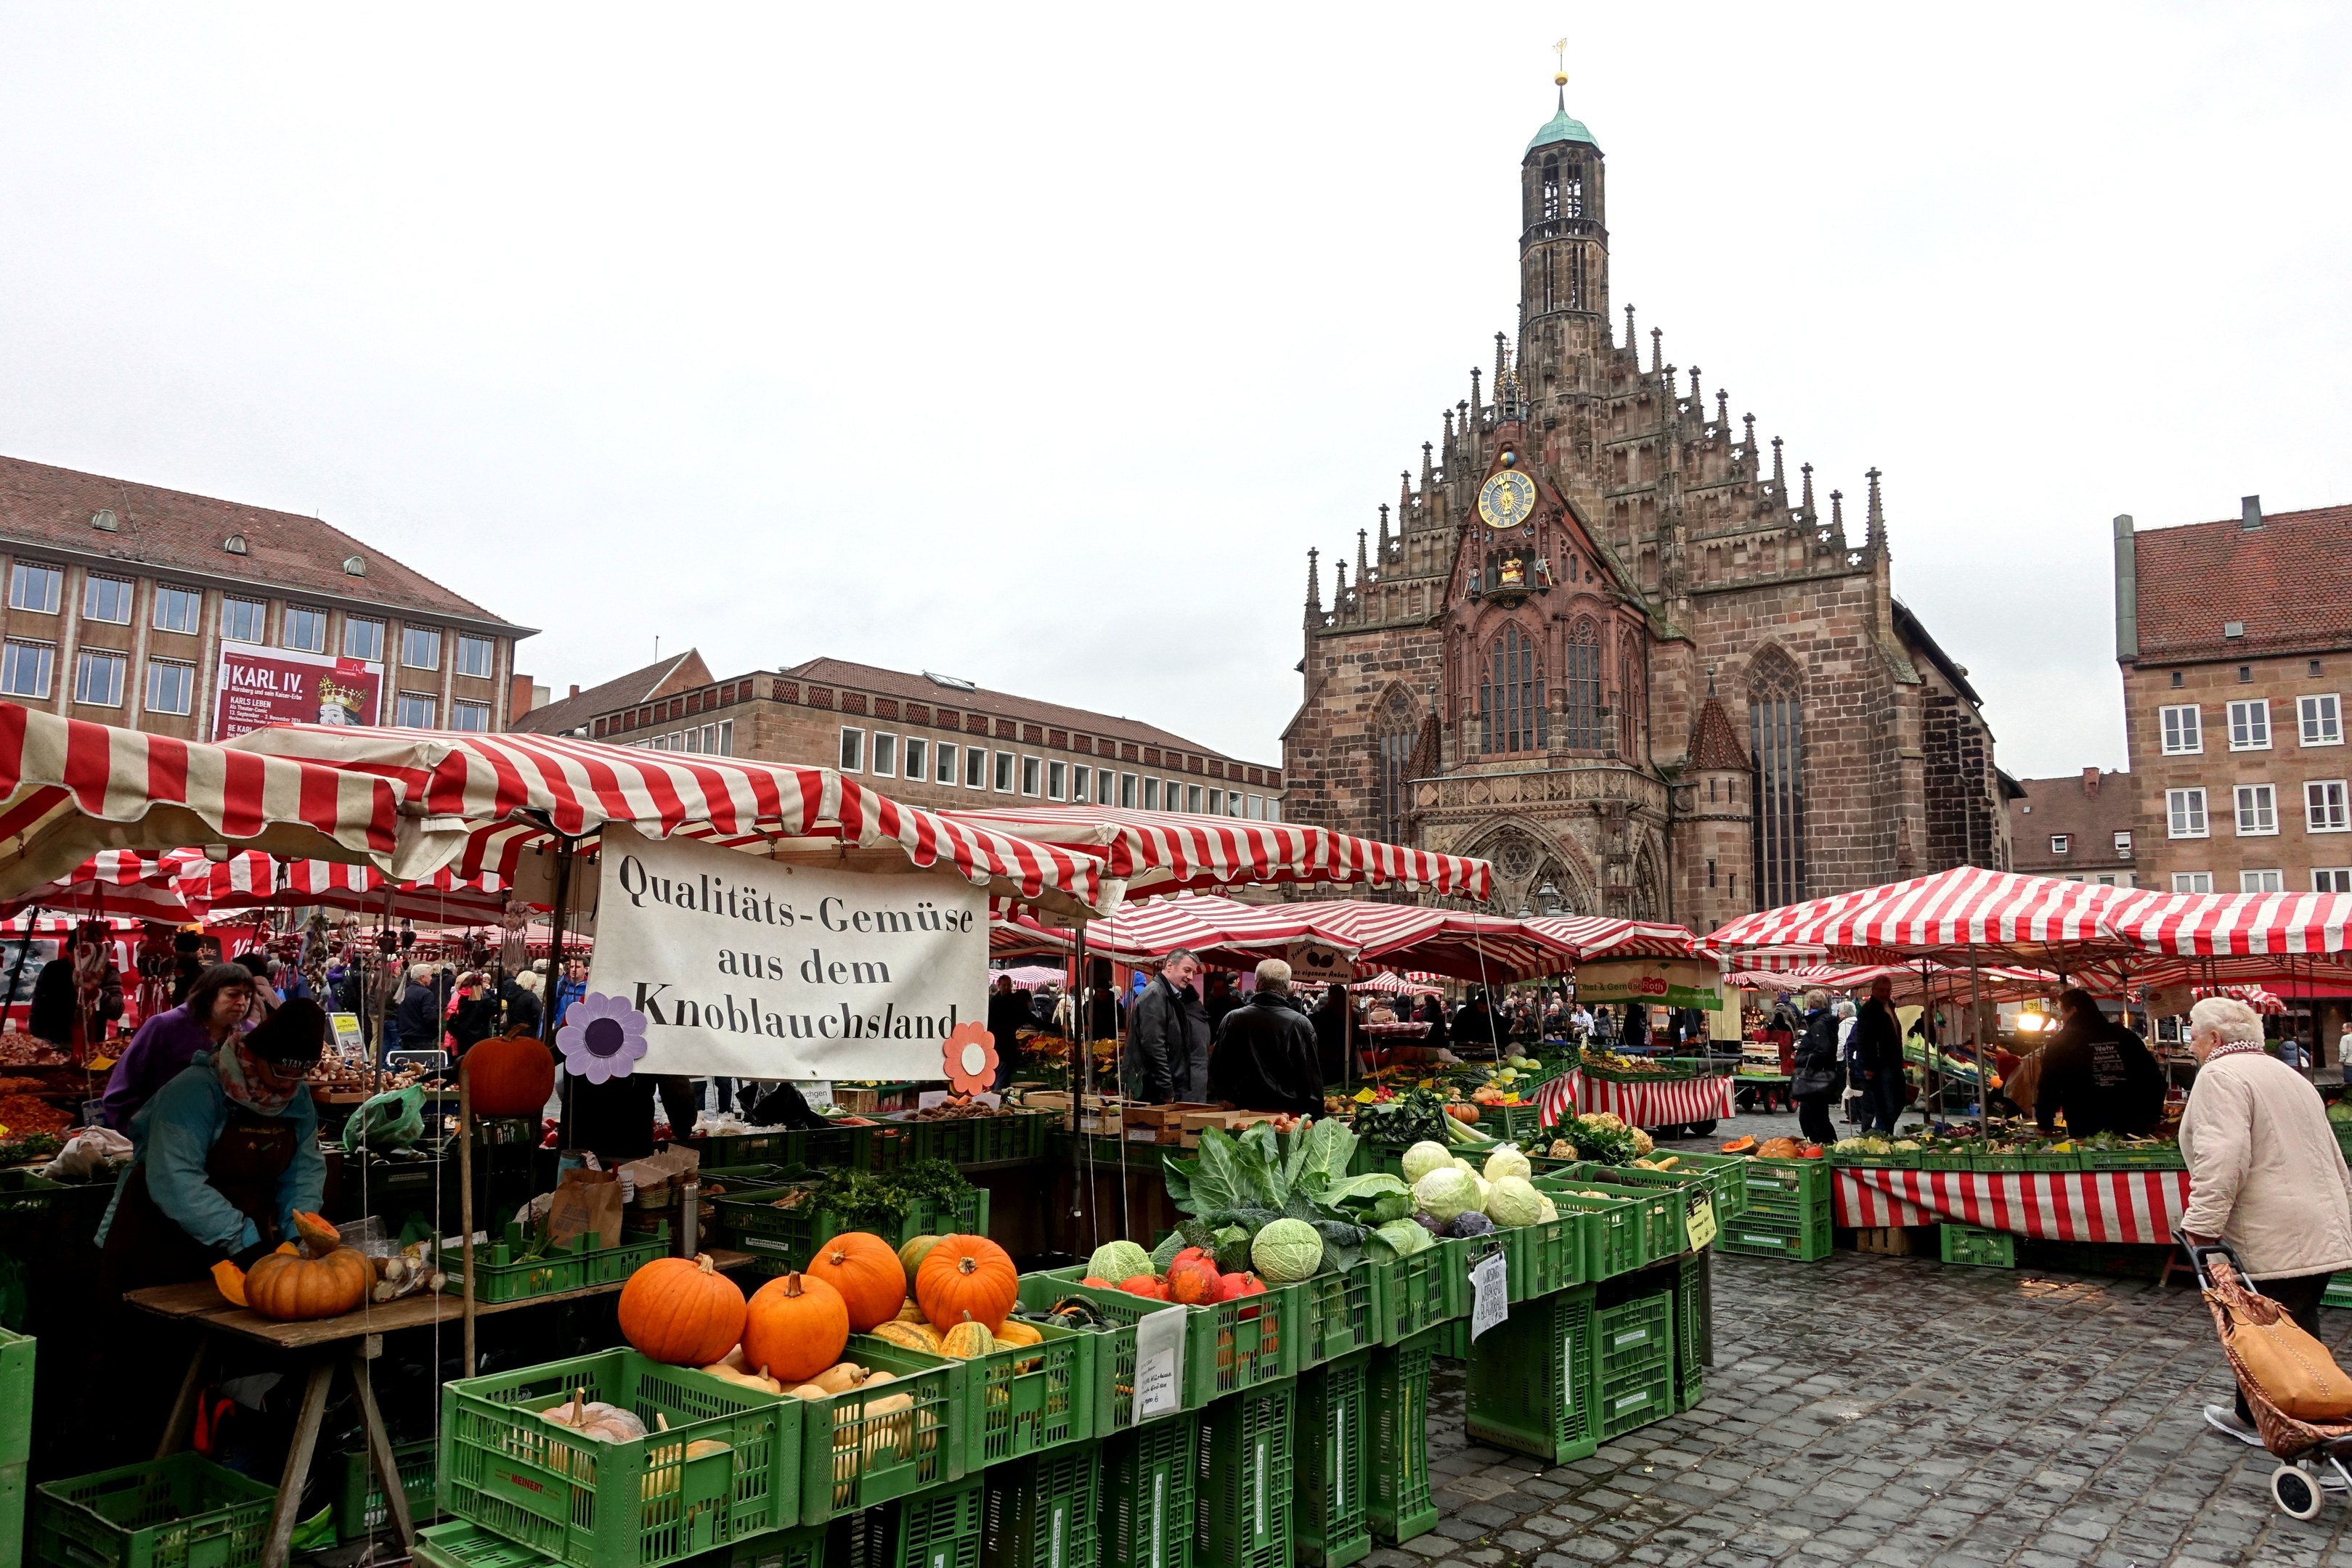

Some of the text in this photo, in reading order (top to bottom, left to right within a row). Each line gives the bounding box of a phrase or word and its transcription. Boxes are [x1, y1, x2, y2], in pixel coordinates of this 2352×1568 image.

[232, 665, 278, 690] KARL
[284, 673, 302, 693] IV.
[231, 686, 254, 695] Nürnberg
[275, 691, 302, 700] Kaiser-Erbe
[231, 696, 271, 708] KARLS LEBEN
[619, 854, 974, 933] Qualitäts-Gemüse
[718, 948, 893, 985] aus dem
[1578, 983, 1597, 991] Obst
[1642, 981, 1664, 991] Roth
[633, 981, 957, 1040] Knoblauchsland
[282, 1058, 302, 1069] STAY
[511, 1473, 544, 1494] MEINERT
